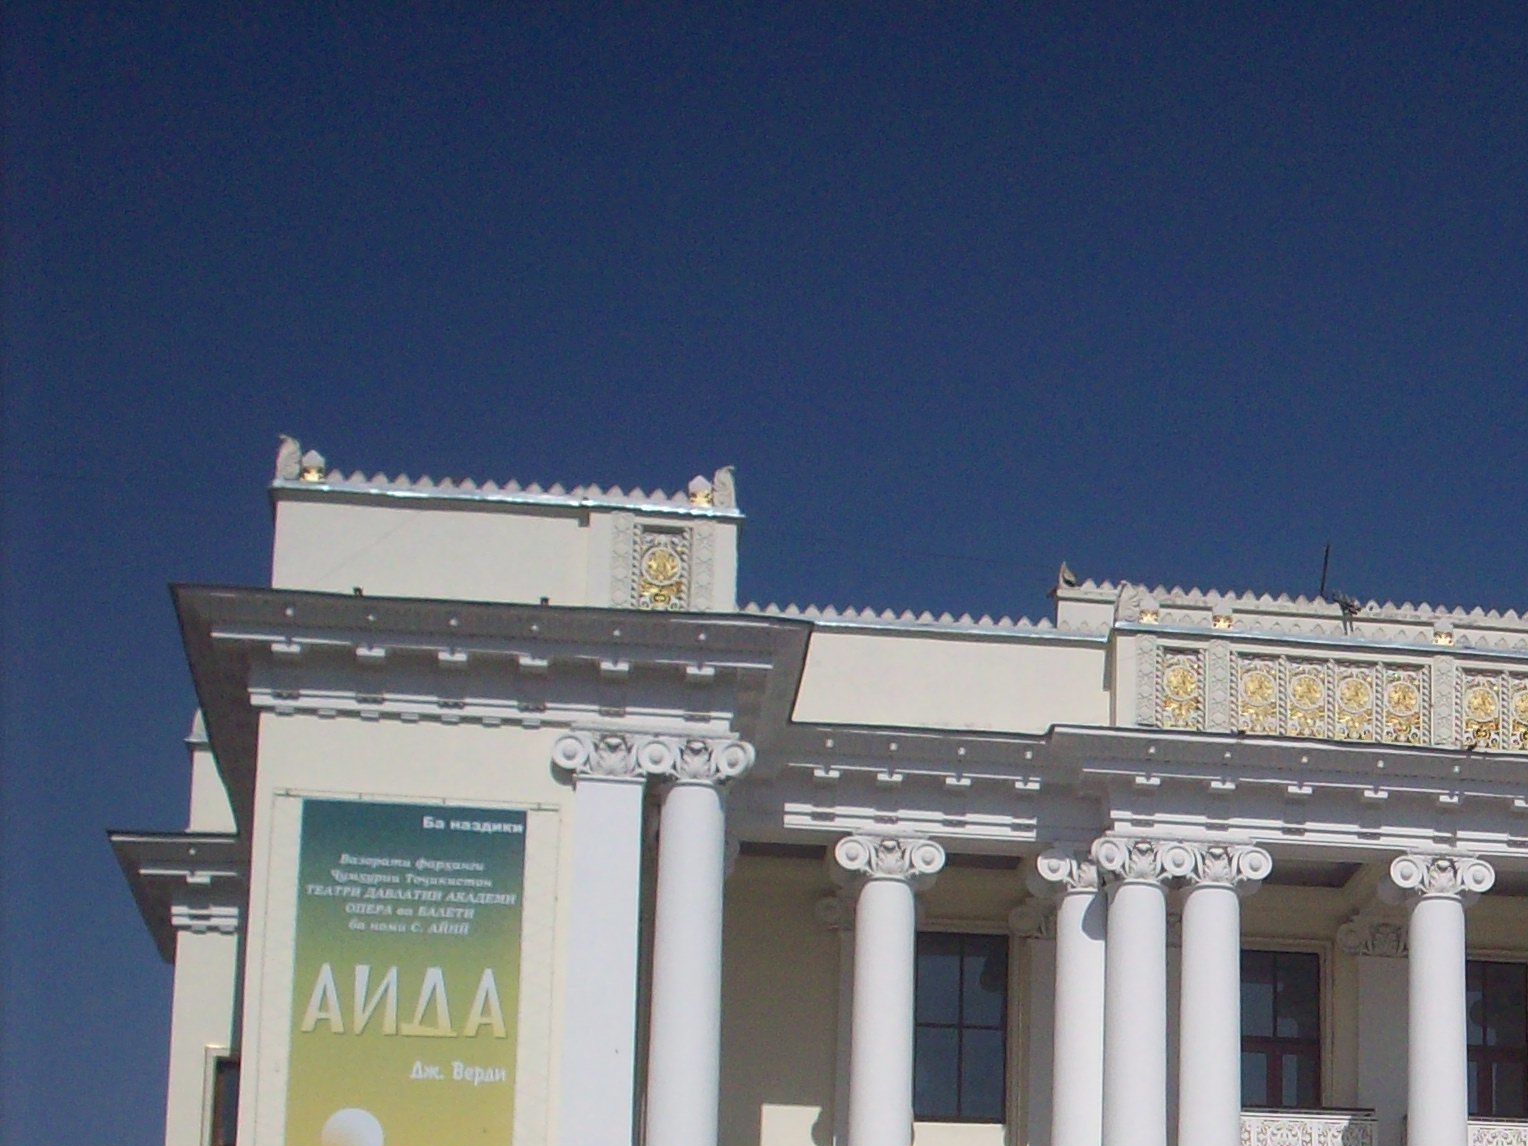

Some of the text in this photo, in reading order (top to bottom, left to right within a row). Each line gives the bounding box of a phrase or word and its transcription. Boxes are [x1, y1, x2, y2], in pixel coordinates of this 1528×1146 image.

[422, 816, 524, 834] Ба наздики
[305, 884, 361, 897] ТЕАТРИ
[345, 902, 392, 915] ОПЕРА
[418, 905, 475, 919] БАЛЕТИ
[348, 919, 366, 930] ба
[301, 962, 508, 1038] АИДА
[410, 1060, 506, 1086] Дж. Верди
